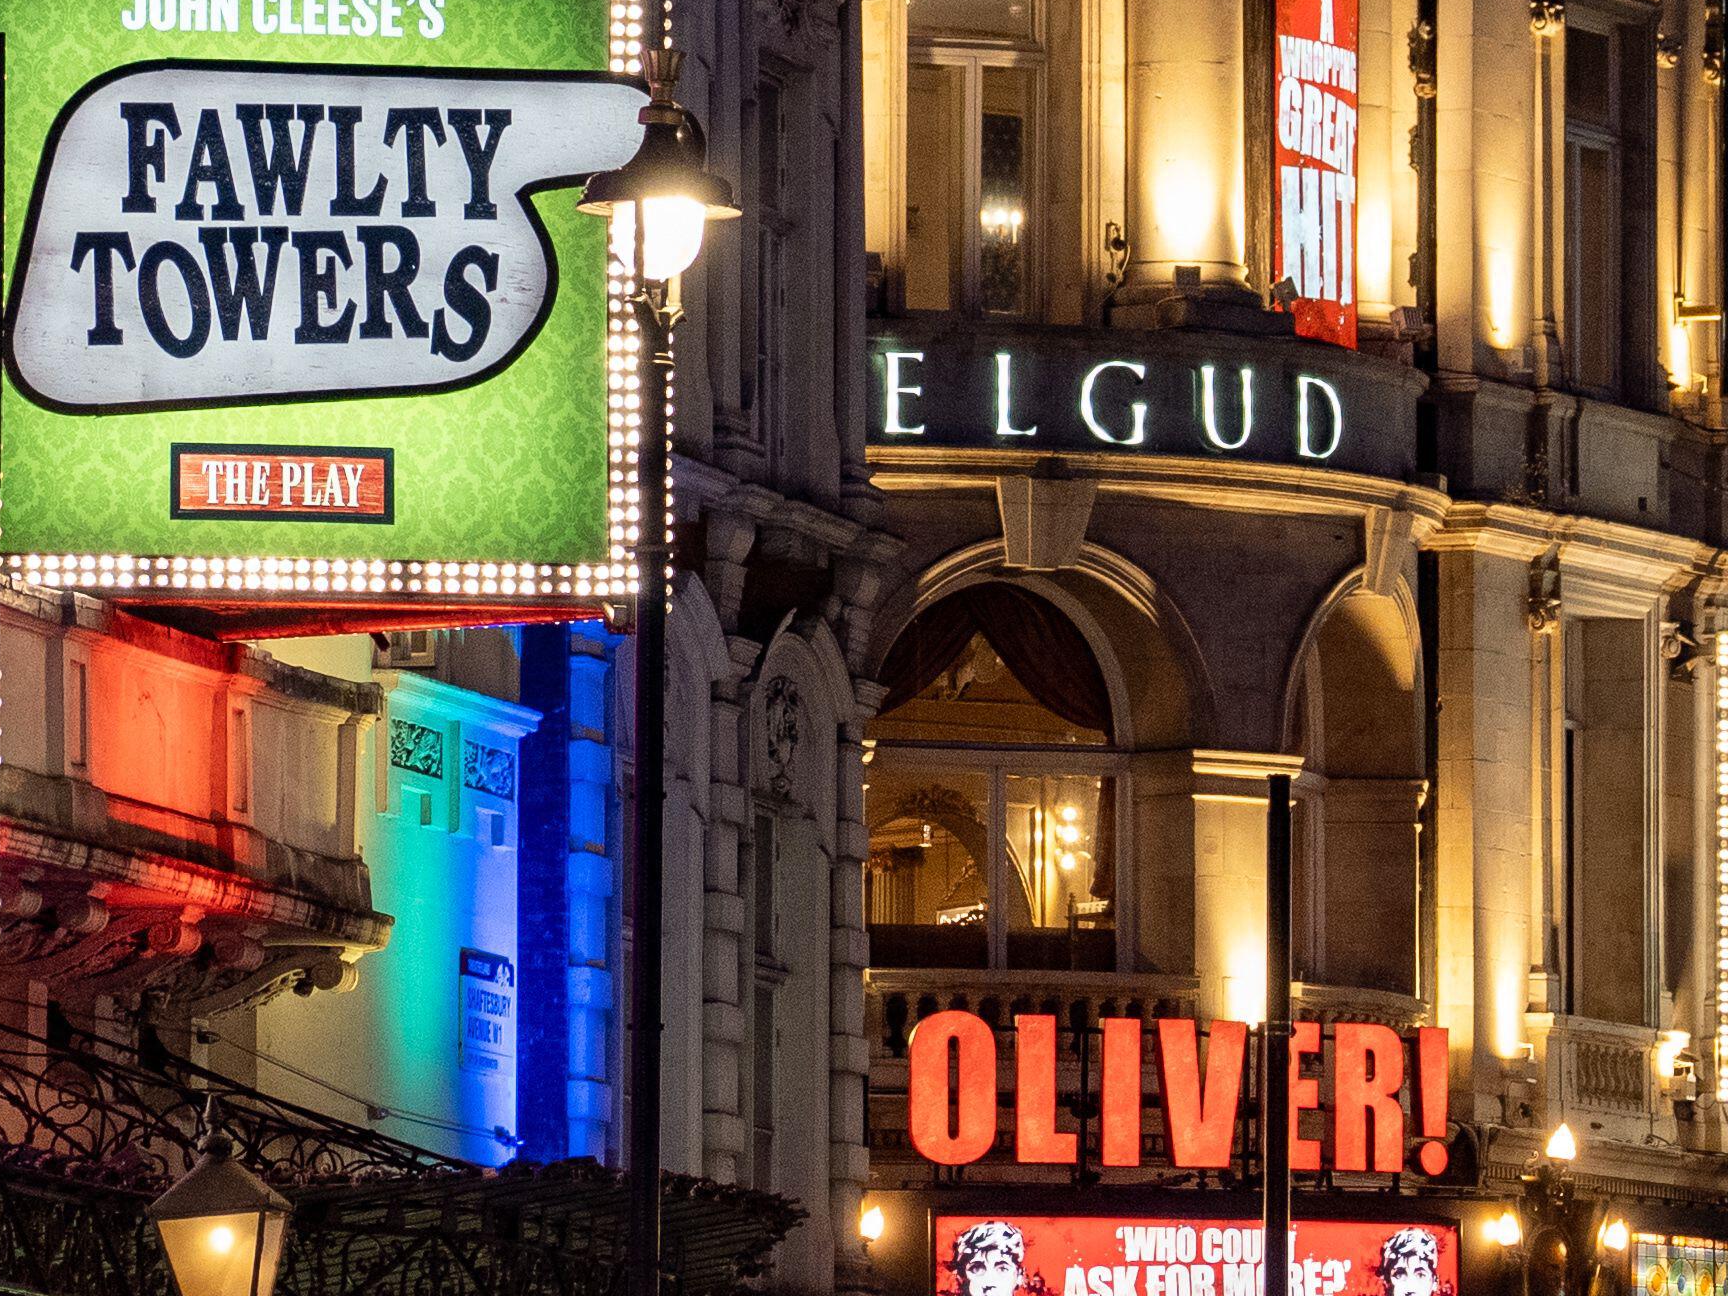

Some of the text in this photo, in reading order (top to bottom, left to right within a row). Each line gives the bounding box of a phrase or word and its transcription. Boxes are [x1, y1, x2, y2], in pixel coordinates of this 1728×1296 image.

[120, 102, 512, 222] FAWLTY
[1278, 75, 1356, 175] GREAT
[1280, 165, 1356, 305] HIT
[71, 225, 500, 363] TOWERS
[201, 460, 363, 509] THE PLAY
[1116, 1226, 1296, 1264] 'WHO COU
